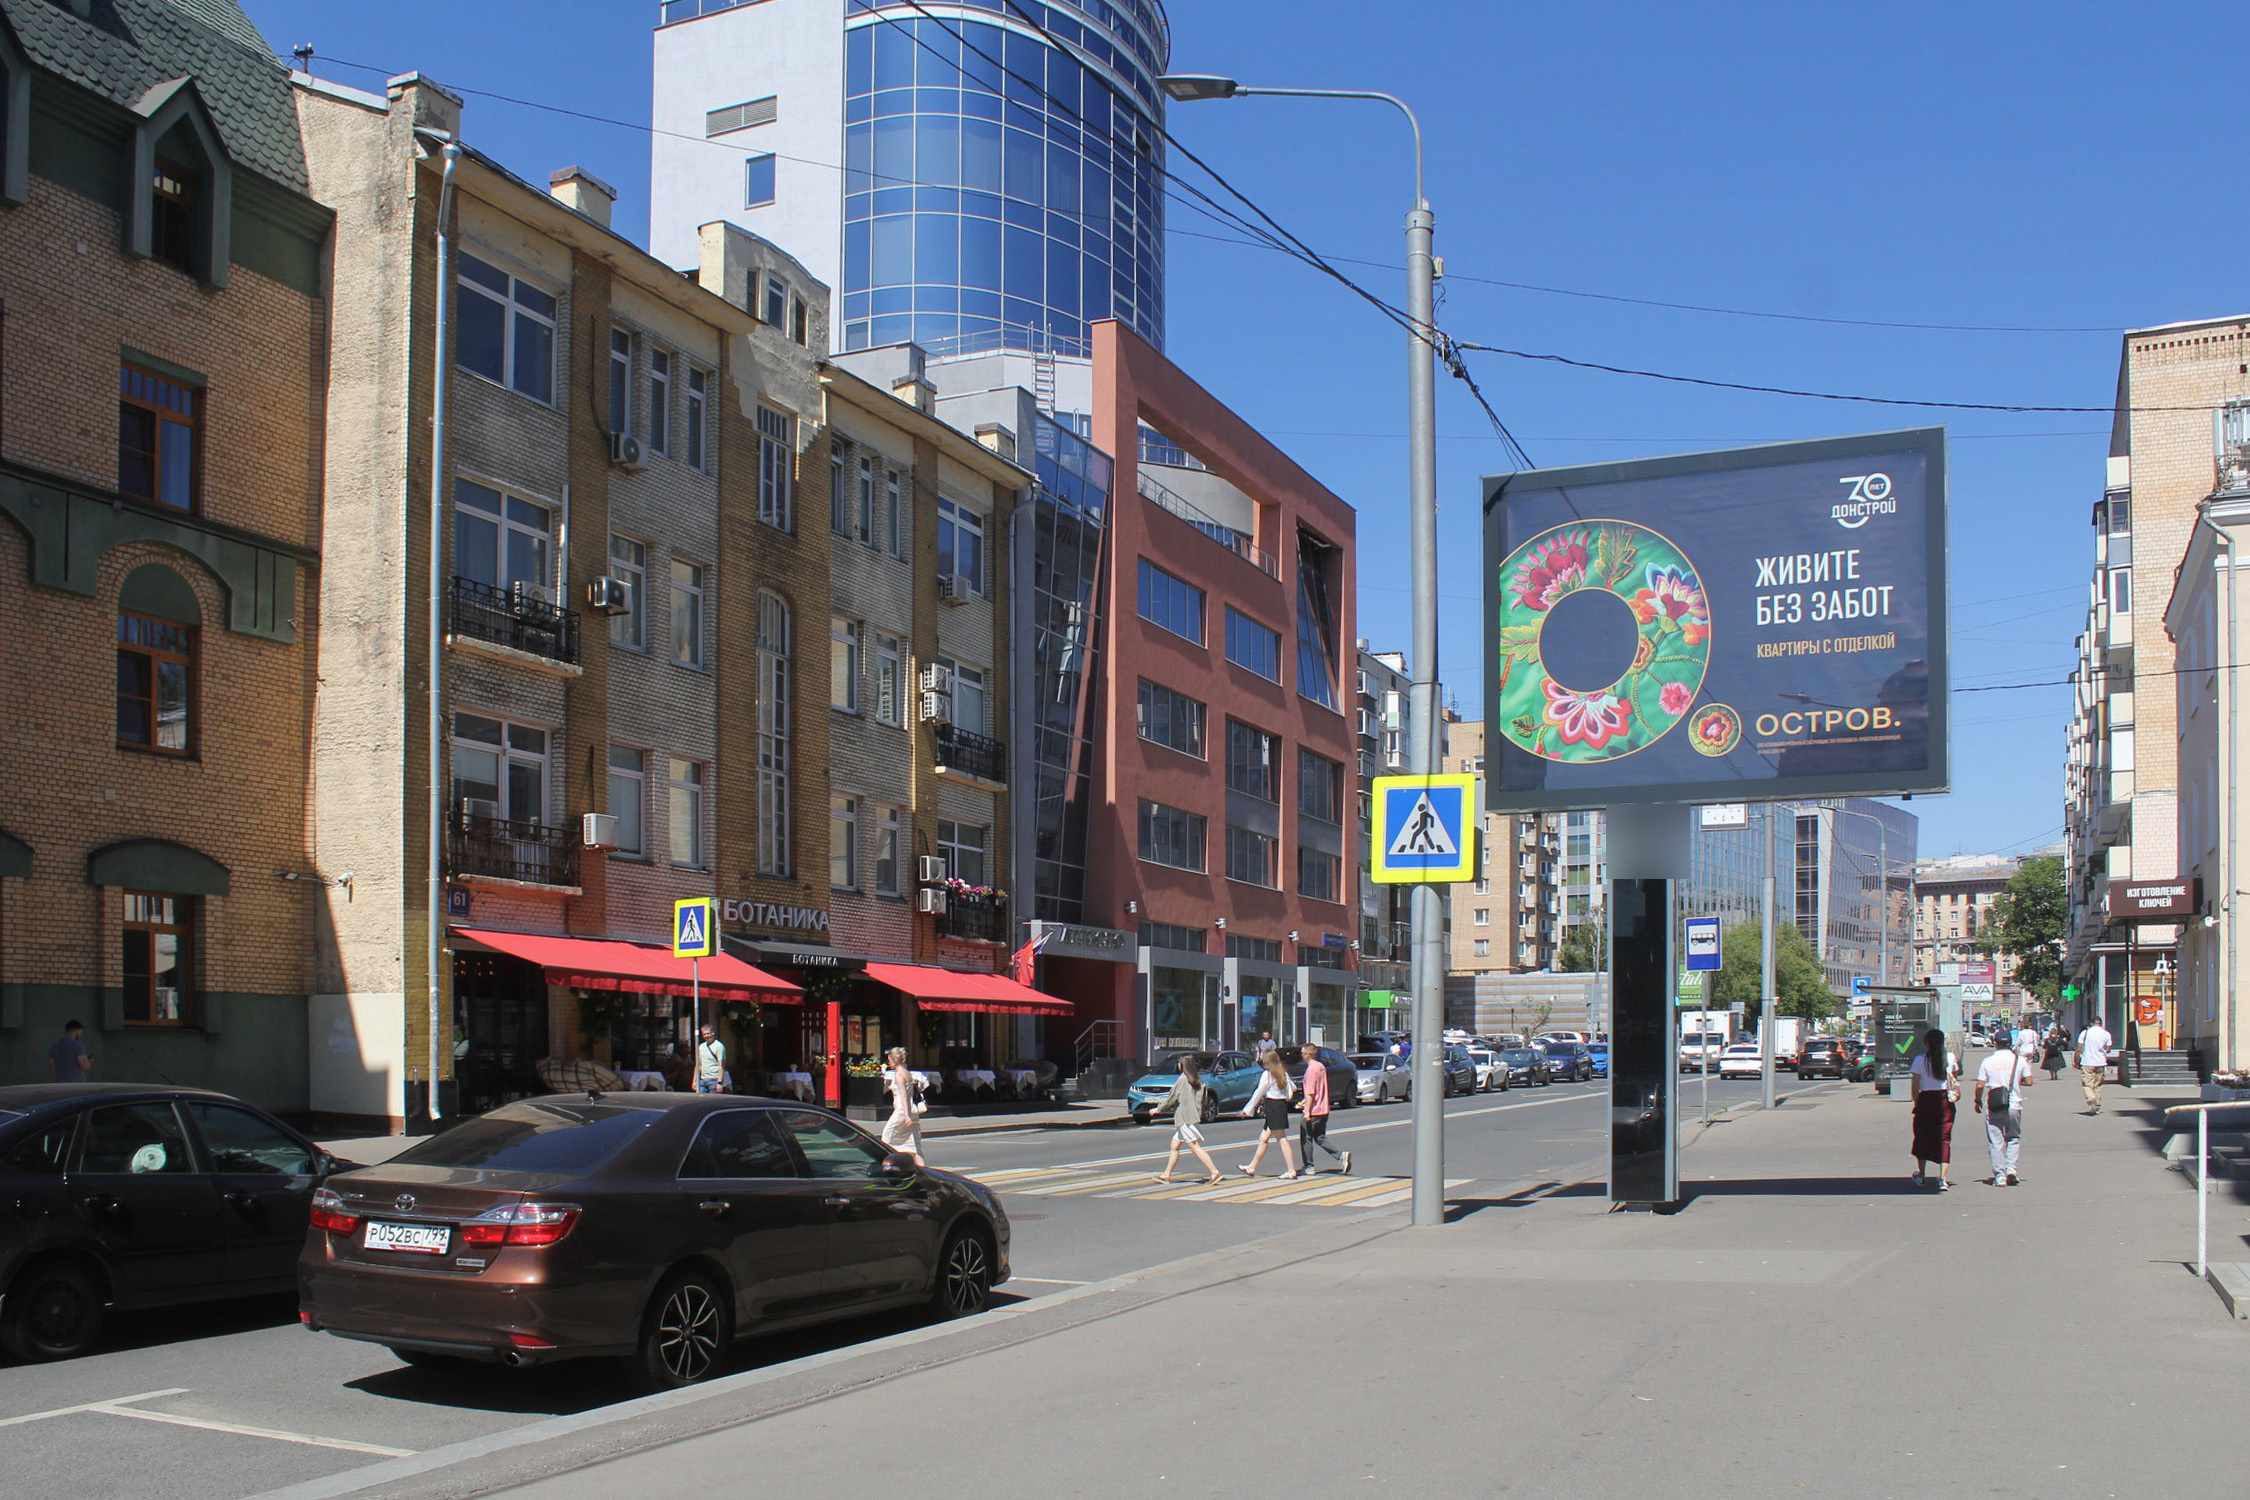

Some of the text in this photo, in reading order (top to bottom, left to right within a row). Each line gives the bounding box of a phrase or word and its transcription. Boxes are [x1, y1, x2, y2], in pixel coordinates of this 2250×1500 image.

[1839, 472, 1892, 502] 30
[1869, 483, 1885, 491] ЛЕТ
[1831, 497, 1896, 518] ДОНСТРОЙ
[1755, 549, 1861, 588] ЖИВИТЕ
[1756, 585, 1894, 626] БЕЗ ЗАБОТ
[1757, 631, 1896, 659] КВАРТИРЫ С ОТДЕЛКОЙ
[1755, 706, 1902, 737] ОСТРОВ.
[453, 891, 467, 907] 61
[2126, 885, 2186, 898] ИЗГОТОВЛЕНИЕ
[2138, 896, 2172, 909] КЛЮЧЕЙ
[723, 898, 830, 931] БОТАНИКА
[793, 954, 839, 966] БОТАНИКА
[1962, 985, 1991, 995] AVA
[425, 1227, 446, 1241] 799
